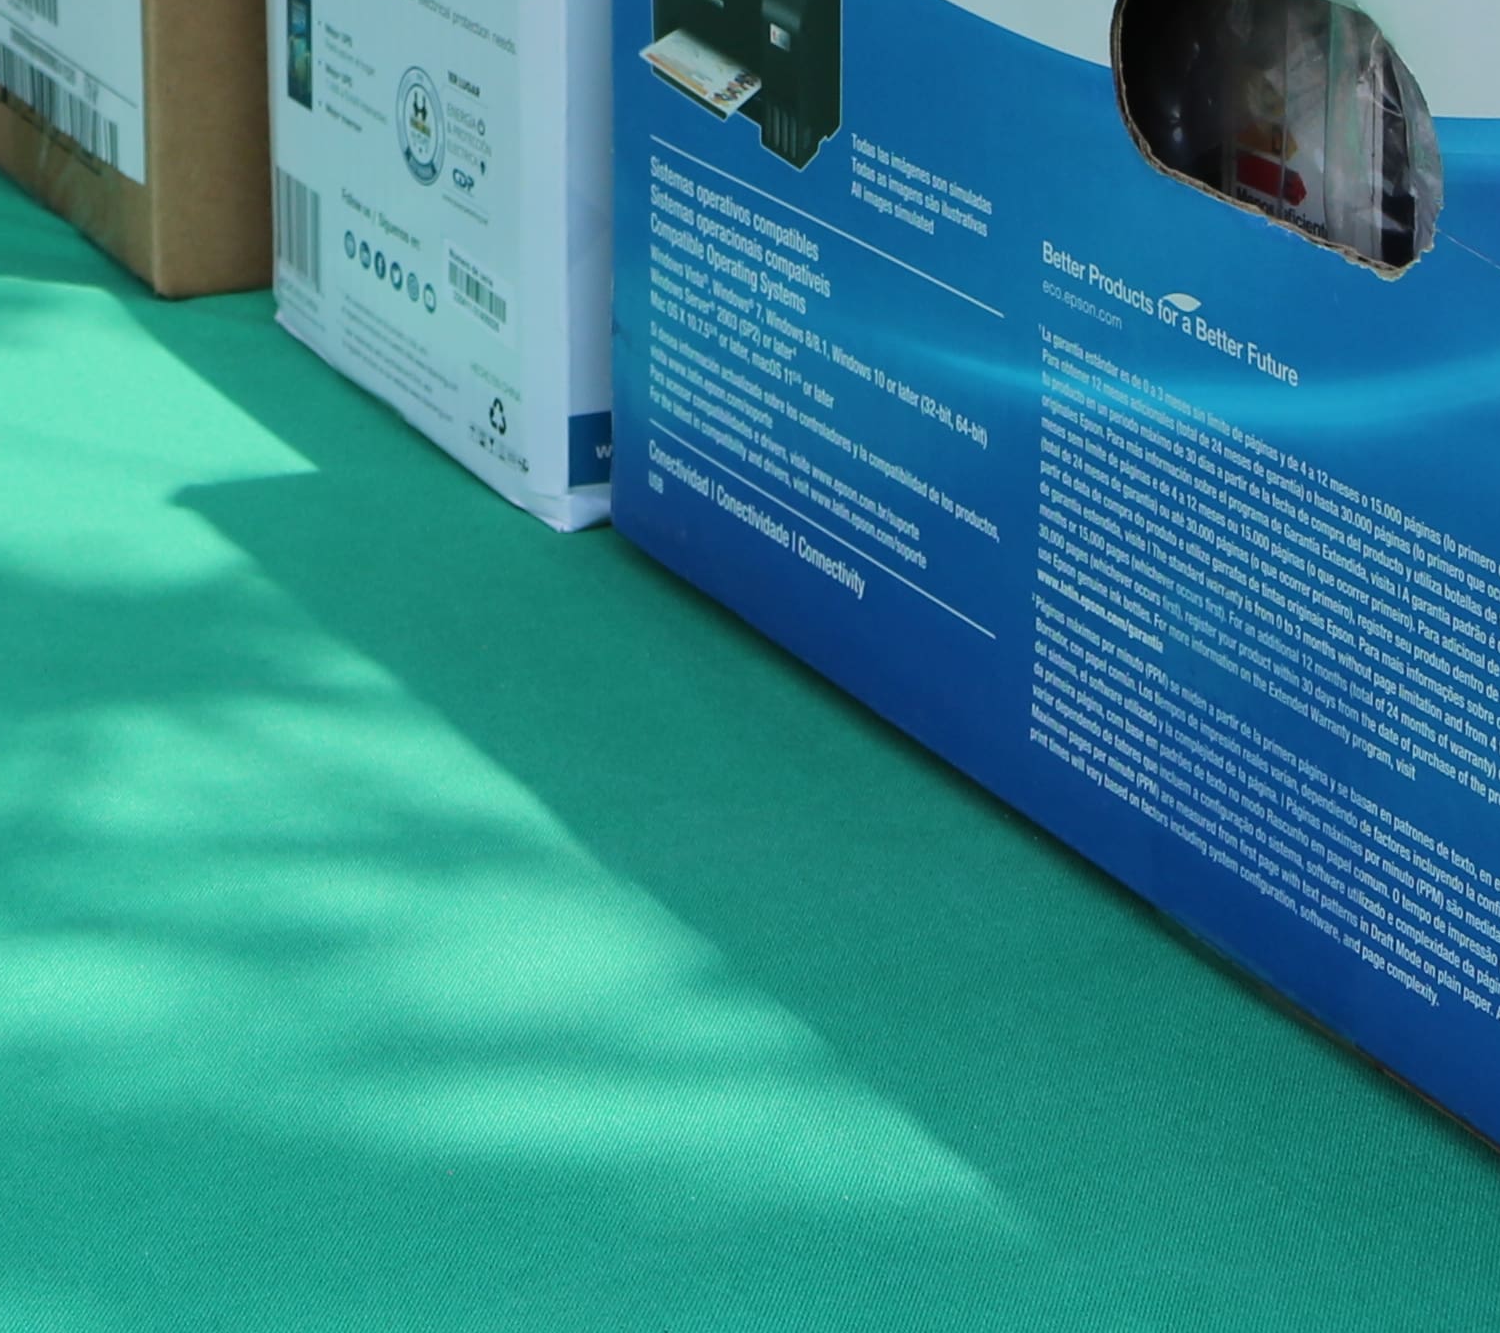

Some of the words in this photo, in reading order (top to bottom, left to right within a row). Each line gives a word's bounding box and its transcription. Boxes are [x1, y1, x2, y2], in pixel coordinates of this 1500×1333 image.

[707, 244, 758, 293] Operating
[760, 271, 807, 315] Systems
[1042, 279, 1123, 331] eco.epson.com
[1042, 241, 1085, 281] Better
[1089, 263, 1154, 316] Products
[1158, 298, 1179, 328] for
[1182, 315, 1192, 335] a
[1196, 316, 1244, 360] Better
[1247, 342, 1299, 387] Future
